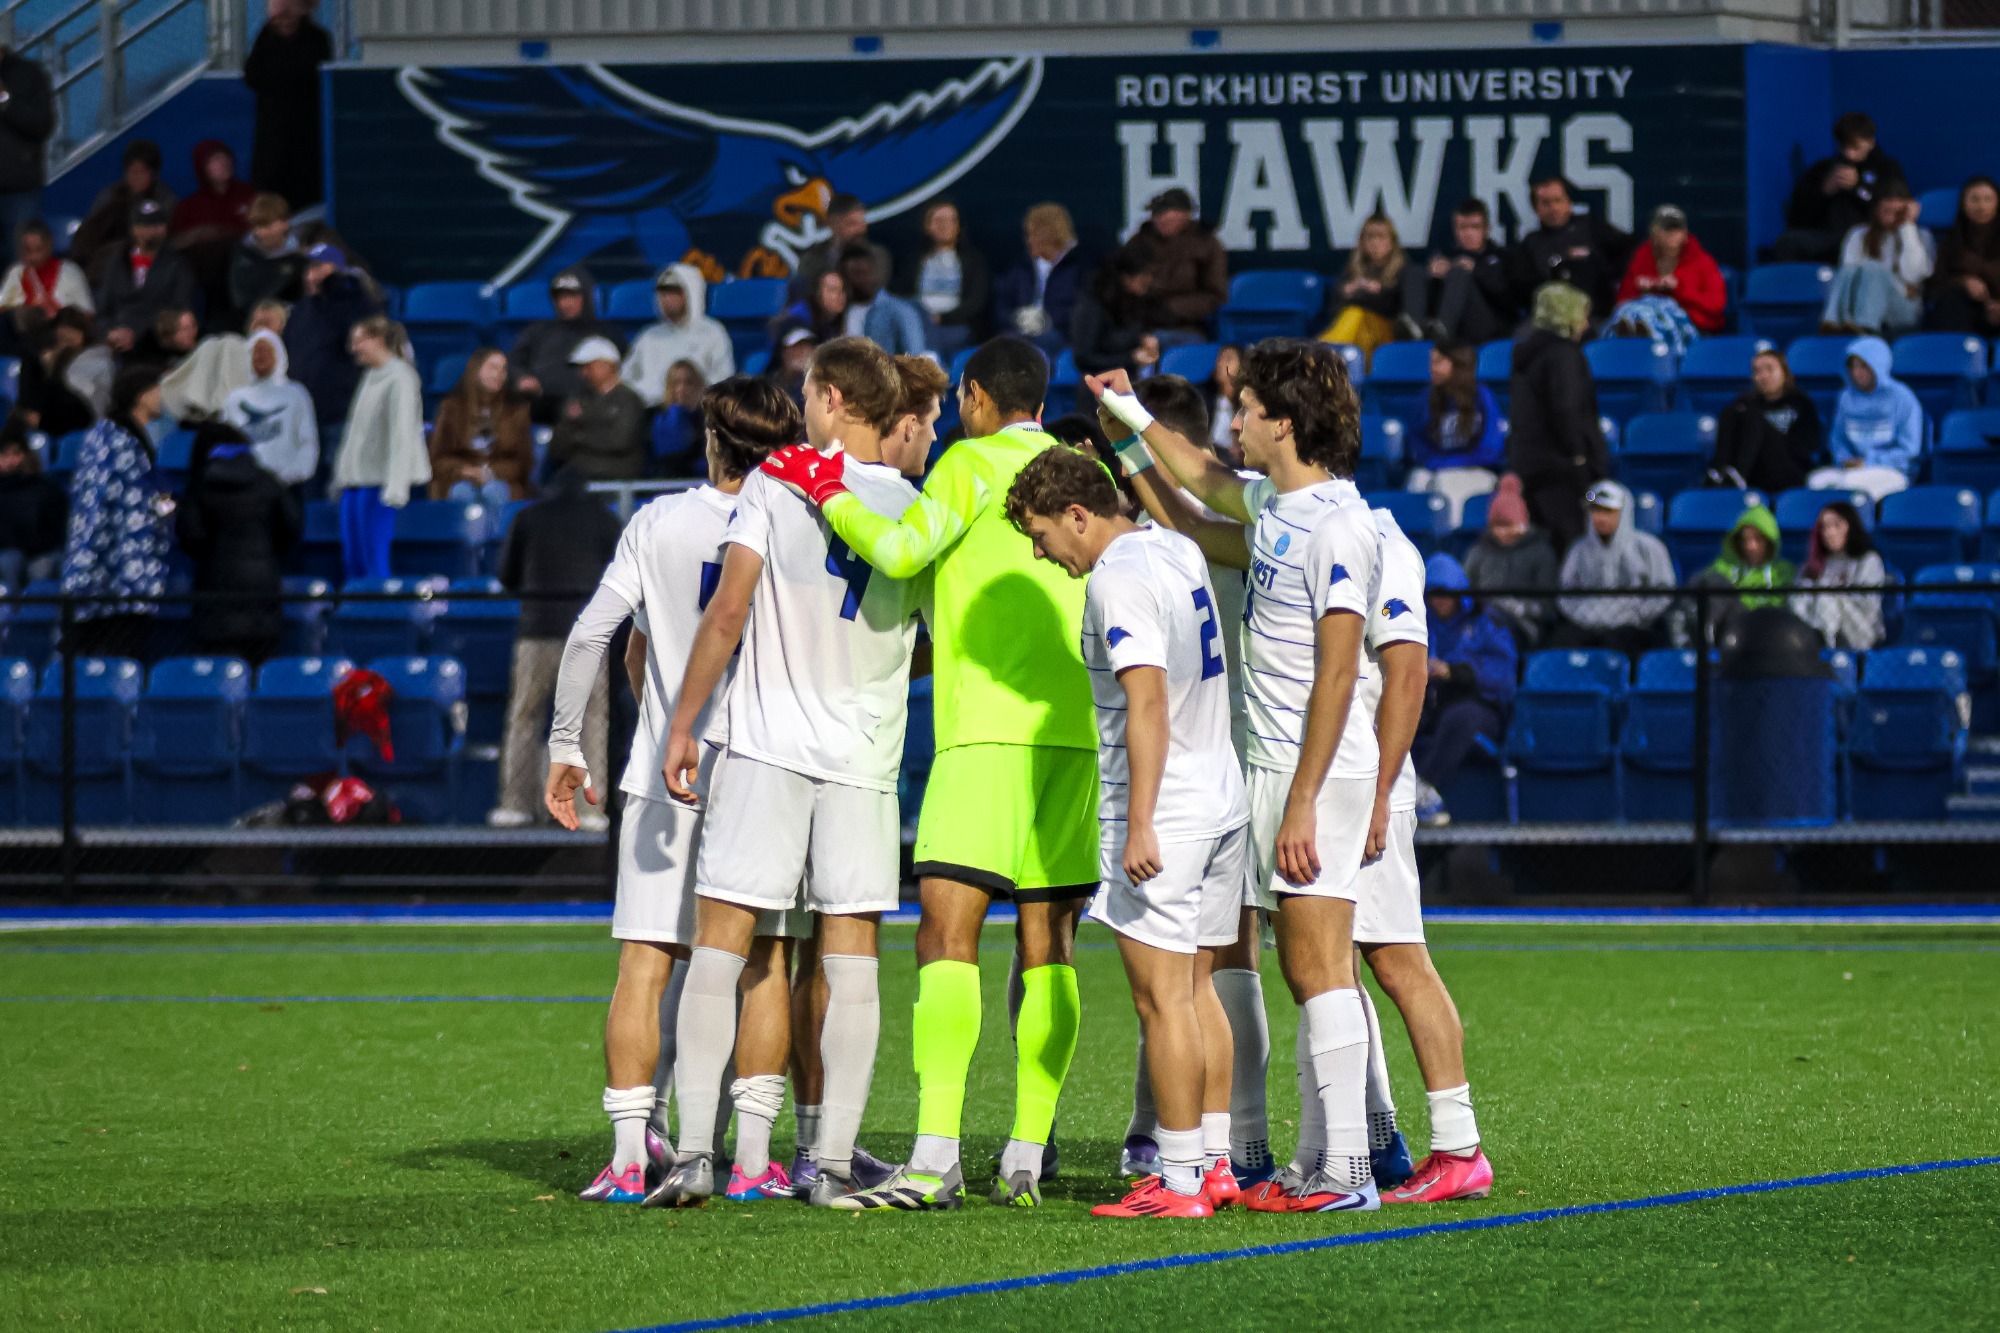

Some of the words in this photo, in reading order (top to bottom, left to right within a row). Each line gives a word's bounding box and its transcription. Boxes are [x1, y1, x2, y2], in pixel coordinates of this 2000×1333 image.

[1116, 71, 1368, 106] ROCKHURST
[1381, 66, 1633, 102] UNIVERSITY
[1116, 113, 1634, 250] HAWKS
[1191, 586, 1225, 682] 2
